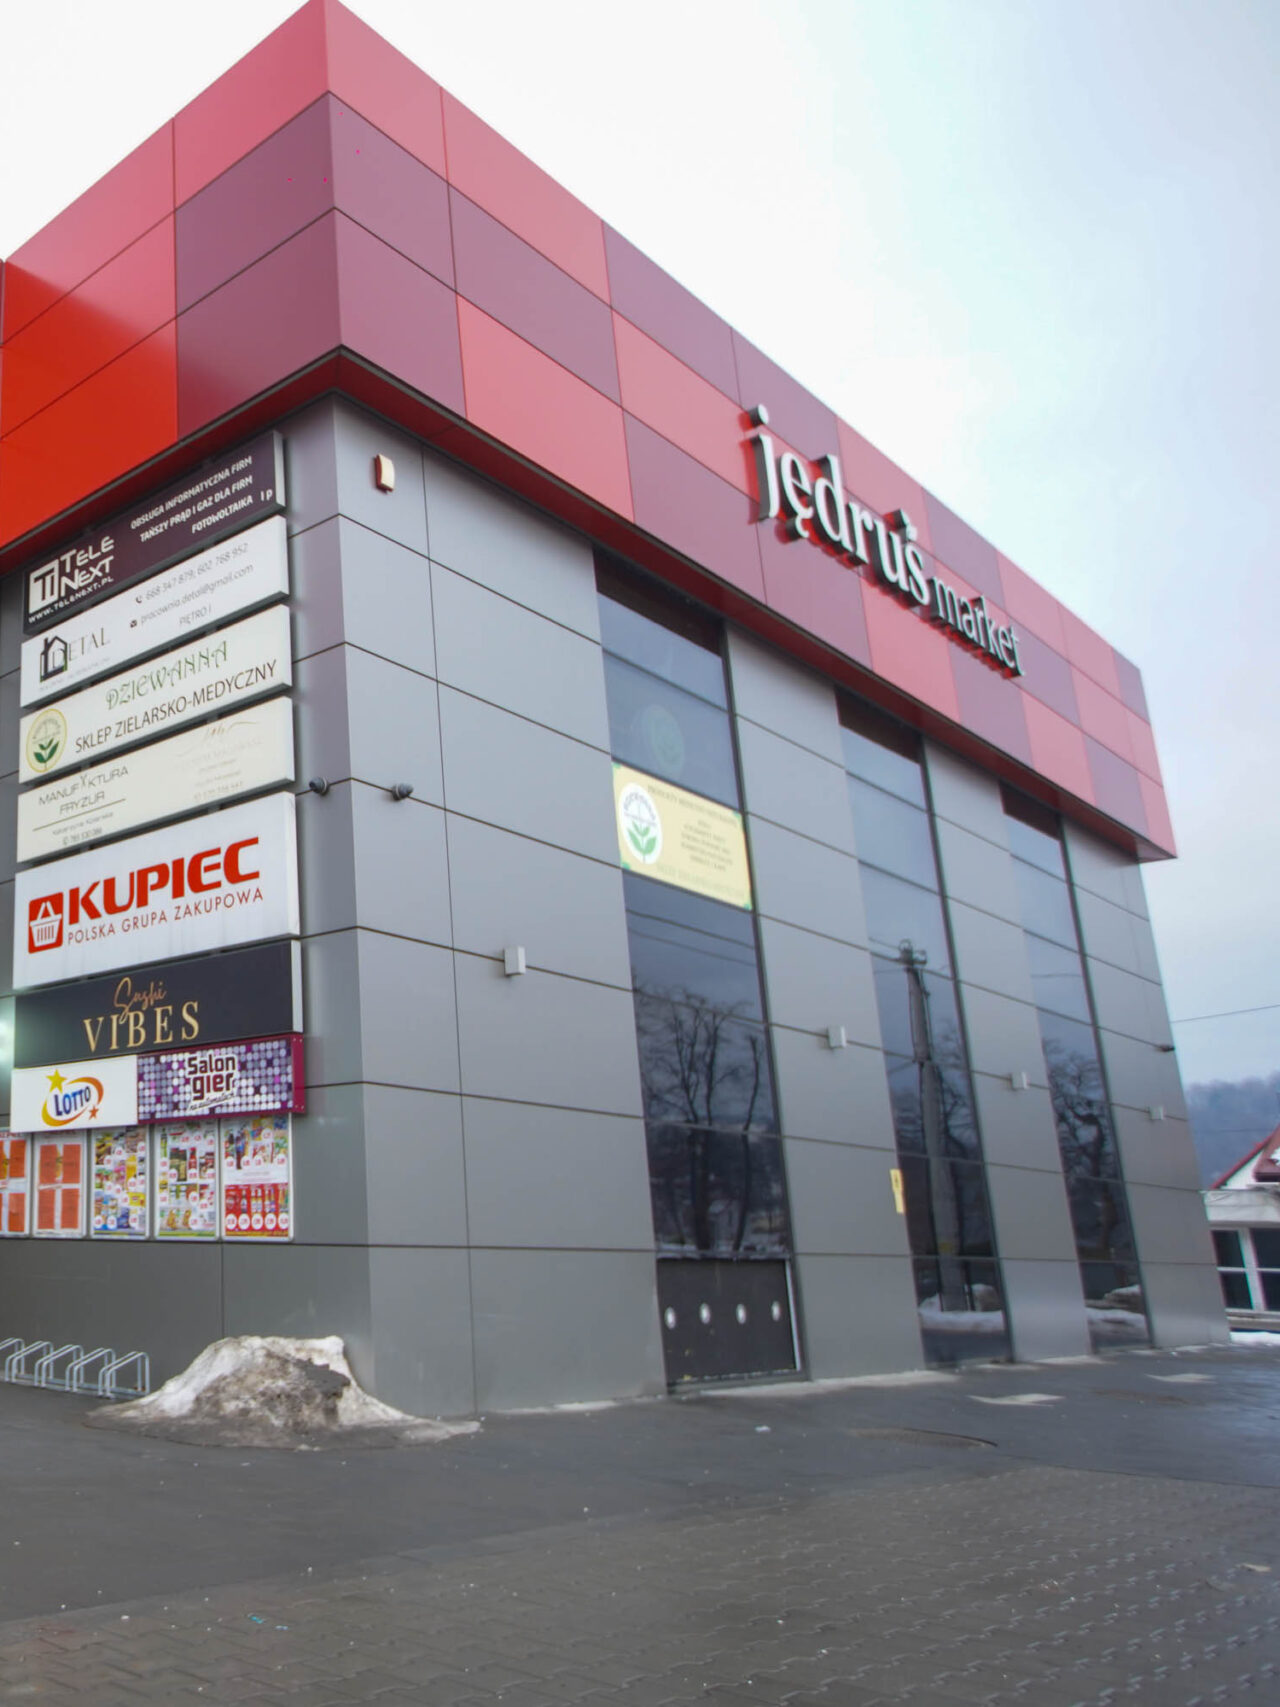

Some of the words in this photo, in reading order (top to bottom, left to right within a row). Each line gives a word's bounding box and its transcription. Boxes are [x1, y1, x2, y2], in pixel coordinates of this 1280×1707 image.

[130, 503, 165, 530] OBSŁUGA
[165, 468, 230, 510] INFORMATYCZNA
[231, 455, 253, 475] FIRM
[191, 494, 253, 534] FOTOWOLTAIKA
[192, 504, 197, 515] I
[196, 495, 215, 512] GAZ
[231, 475, 253, 494] FIRM
[60, 535, 114, 573] TELE
[61, 555, 114, 598] NEXT
[930, 576, 1025, 677] market
[106, 640, 228, 711] DZIEWANNA
[75, 725, 113, 754] SKLEP
[114, 659, 278, 739] ZIELARSKO-MEDYCZNY
[59, 790, 105, 815] FRYZUR
[68, 836, 260, 925] KUPIEC
[67, 923, 116, 946] POLSKA
[121, 909, 168, 933] GRUPA
[173, 886, 264, 921] ZAKUPOWA
[82, 1000, 201, 1052] VIBES
[187, 1053, 236, 1076] Salon
[53, 1085, 92, 1117] LOTTO
[192, 1072, 234, 1101] gier
